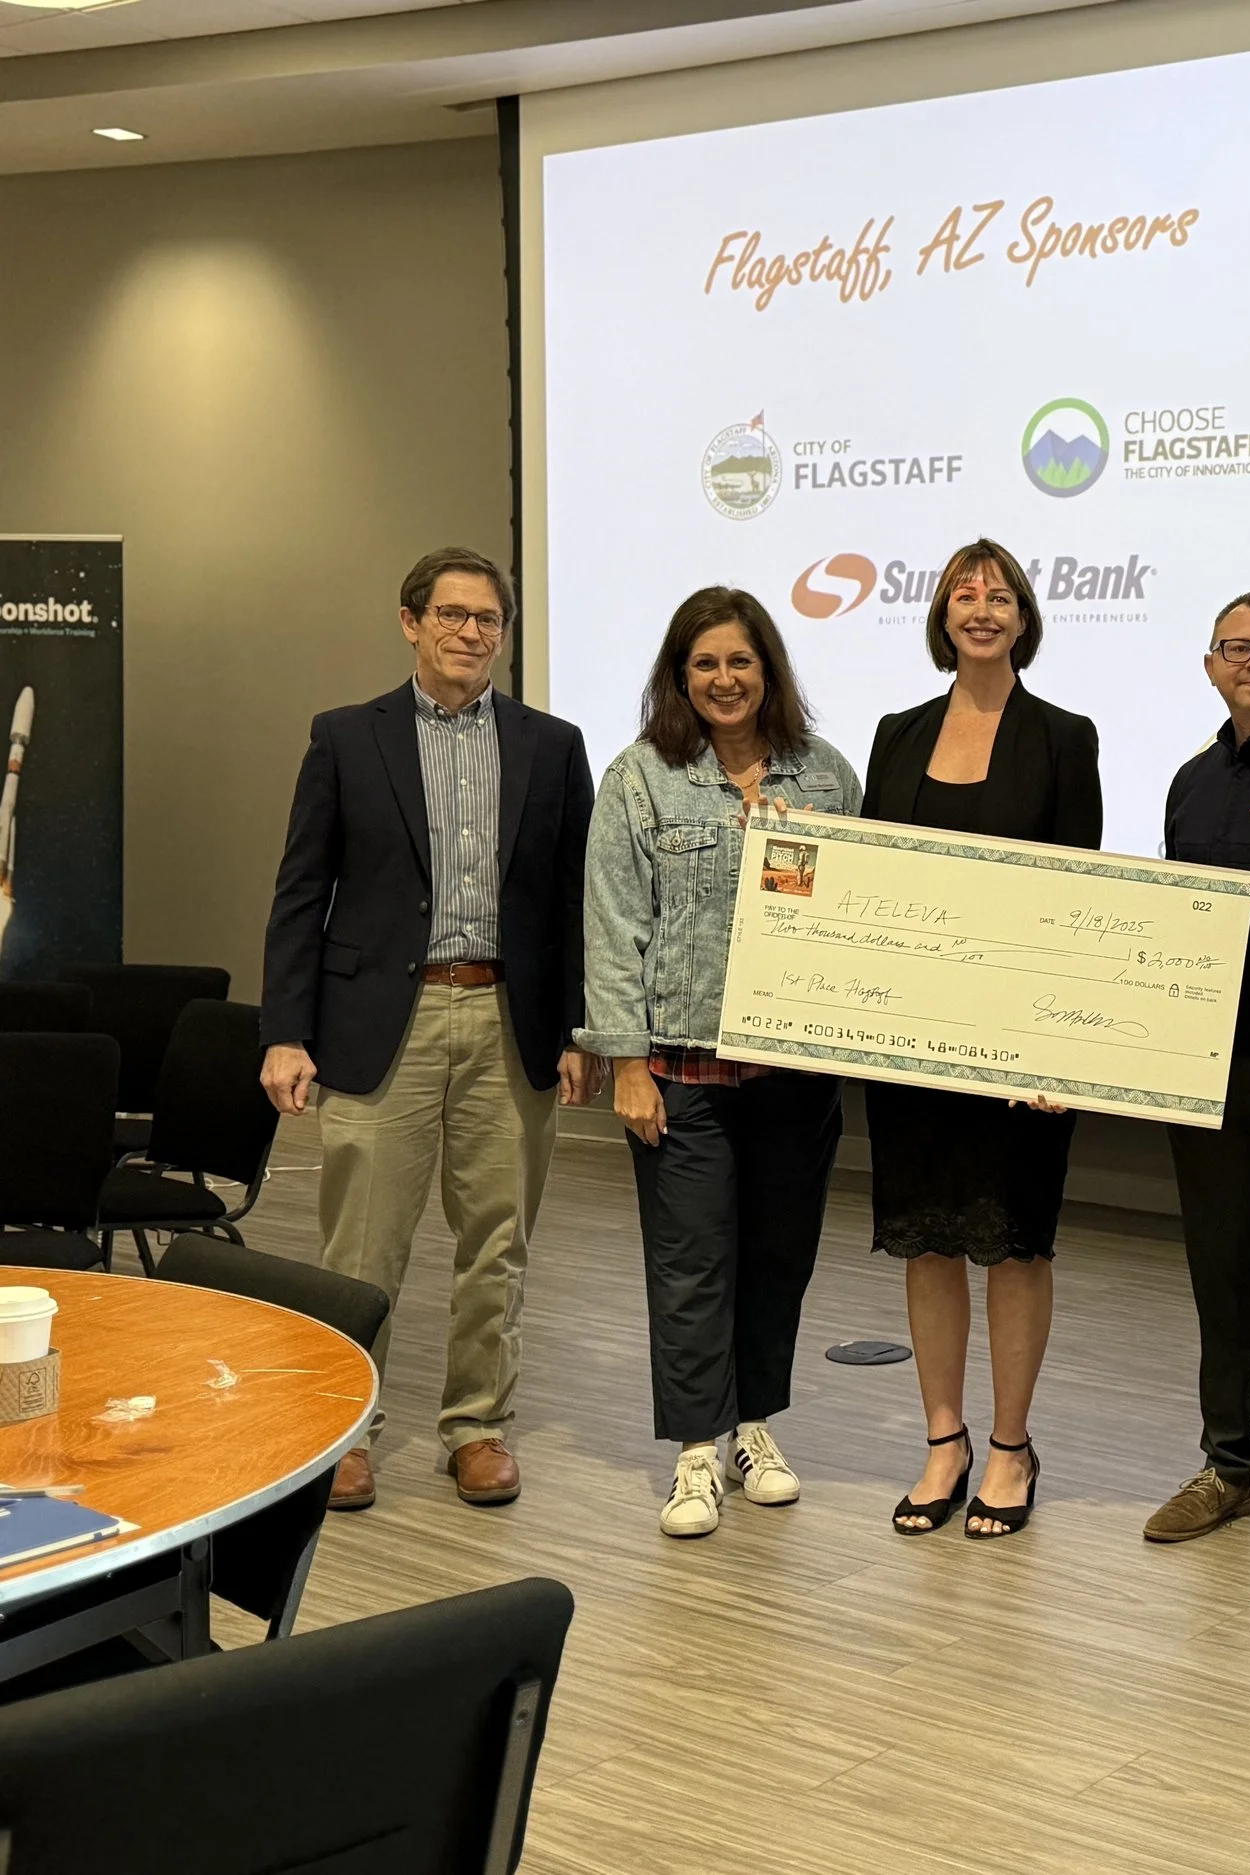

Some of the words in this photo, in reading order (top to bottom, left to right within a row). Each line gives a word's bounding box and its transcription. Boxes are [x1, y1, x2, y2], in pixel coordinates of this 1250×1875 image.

[704, 215, 895, 312] Flagstaff,
[916, 200, 1005, 275] AZ
[1007, 196, 1199, 288] Sponsors
[1124, 406, 1225, 434] CHOOSE
[793, 440, 827, 456] CITY
[831, 439, 852, 454] OF
[794, 455, 963, 490] FLAGSTAFF
[1124, 467, 1145, 479] THE
[1148, 466, 1173, 478] CITY
[1175, 465, 1191, 477] OF
[1047, 554, 1152, 601] Bank
[879, 616, 907, 624] BUILT
[1053, 613, 1149, 623] ENTREPRENEURS
[837, 890, 962, 924] ATELEVA
[1192, 900, 1212, 912] 022
[1137, 951, 1147, 965] $
[1135, 980, 1165, 991] DOLLARS
[753, 990, 774, 998] MEMO
